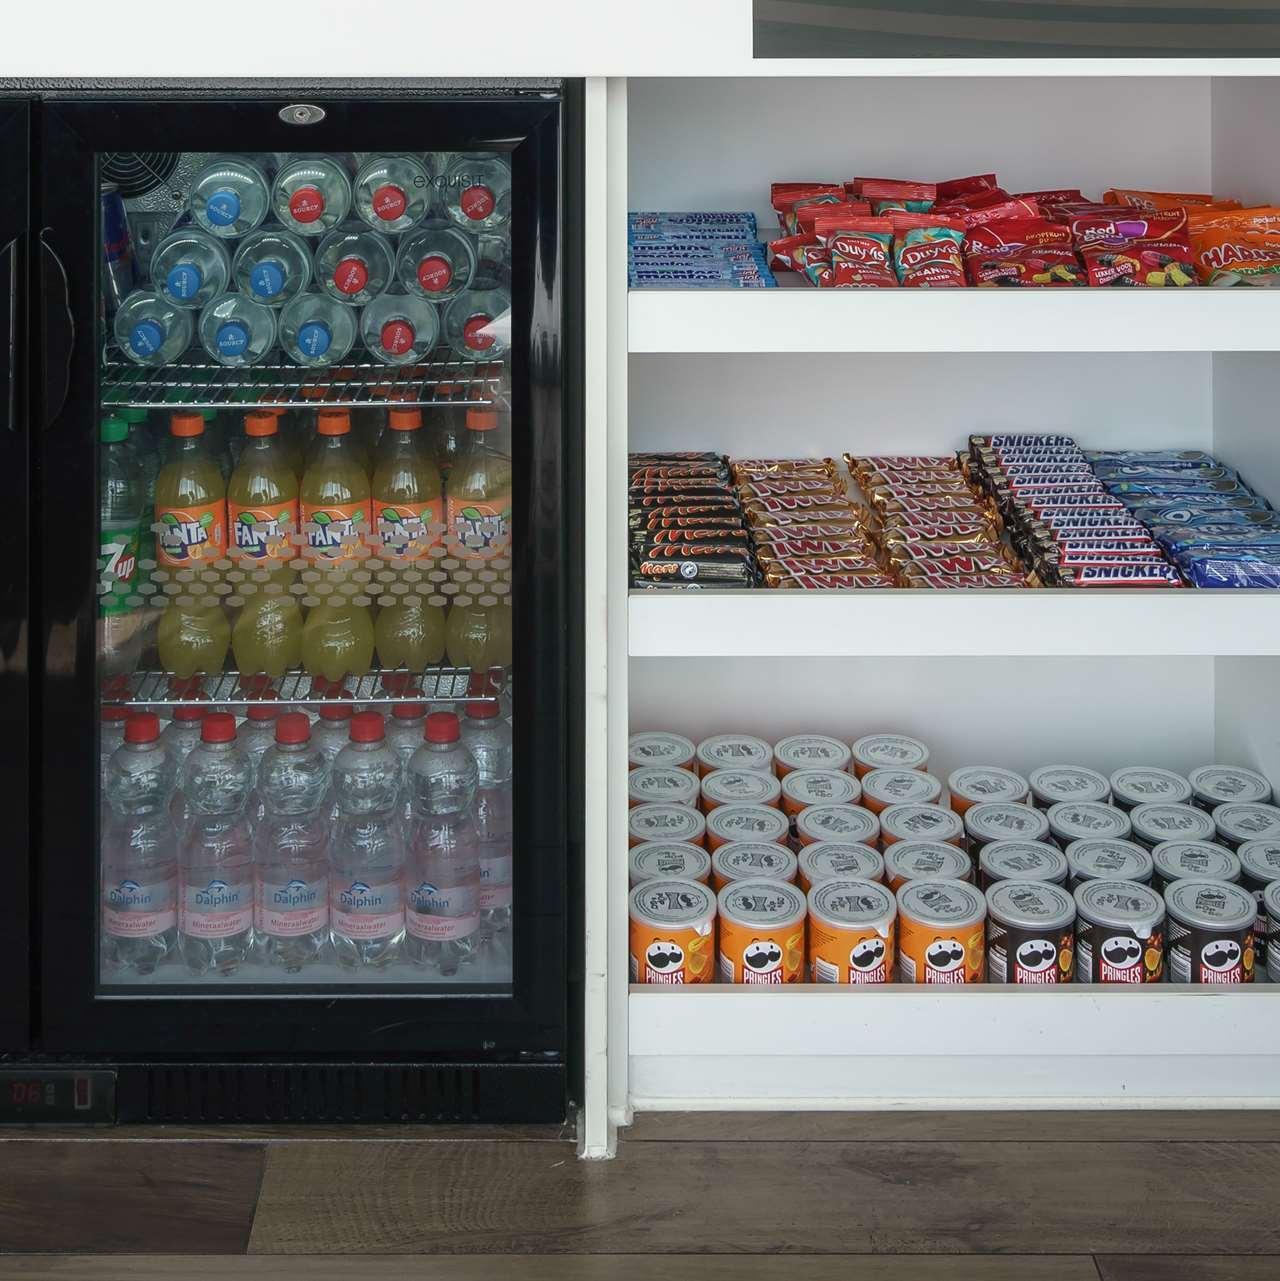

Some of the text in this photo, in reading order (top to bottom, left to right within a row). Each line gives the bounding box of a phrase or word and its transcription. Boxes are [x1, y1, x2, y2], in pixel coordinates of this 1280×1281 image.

[836, 241, 885, 261] Duyvis
[907, 245, 959, 264] Duyvis
[195, 893, 239, 907] Dalphin
[273, 892, 317, 907] Dalphin
[340, 892, 382, 908] Dalphin
[646, 968, 684, 983] PRINGLES
[743, 969, 782, 983] PRINGLES
[850, 966, 886, 983] PRINGLES
[925, 969, 965, 983] PRINGLES
[1015, 968, 1057, 983] PRINGLES
[1100, 966, 1142, 983] PRINGLES
[1201, 968, 1242, 983] PRINGLES
